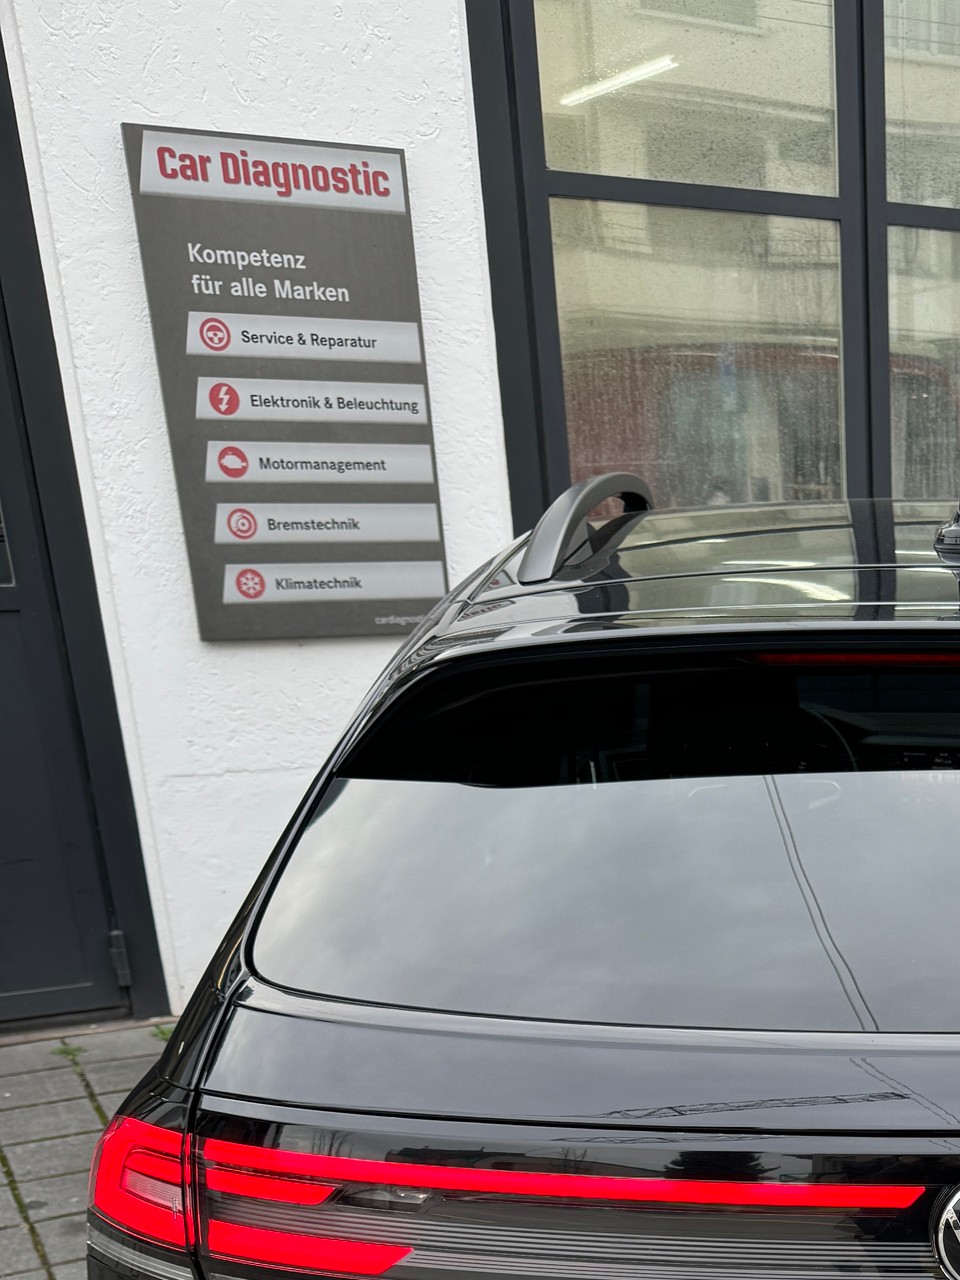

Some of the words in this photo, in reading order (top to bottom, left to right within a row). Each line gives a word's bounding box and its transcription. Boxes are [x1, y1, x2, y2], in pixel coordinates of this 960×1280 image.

[157, 146, 211, 182] Car
[220, 150, 391, 197] Diagnostic
[187, 242, 306, 270] Kompetenz
[191, 274, 223, 296] für
[230, 278, 268, 299] alle
[274, 279, 350, 303] Marken
[240, 330, 294, 346] Service
[297, 333, 308, 346] &
[310, 333, 377, 350] Reparatur
[250, 394, 321, 411] Elektronik
[324, 397, 334, 410] &
[336, 397, 419, 415] Beleuchtung
[258, 457, 387, 474] Motormanagement
[267, 518, 361, 532] Bremstechnik
[275, 575, 363, 591] Klimatechnik
